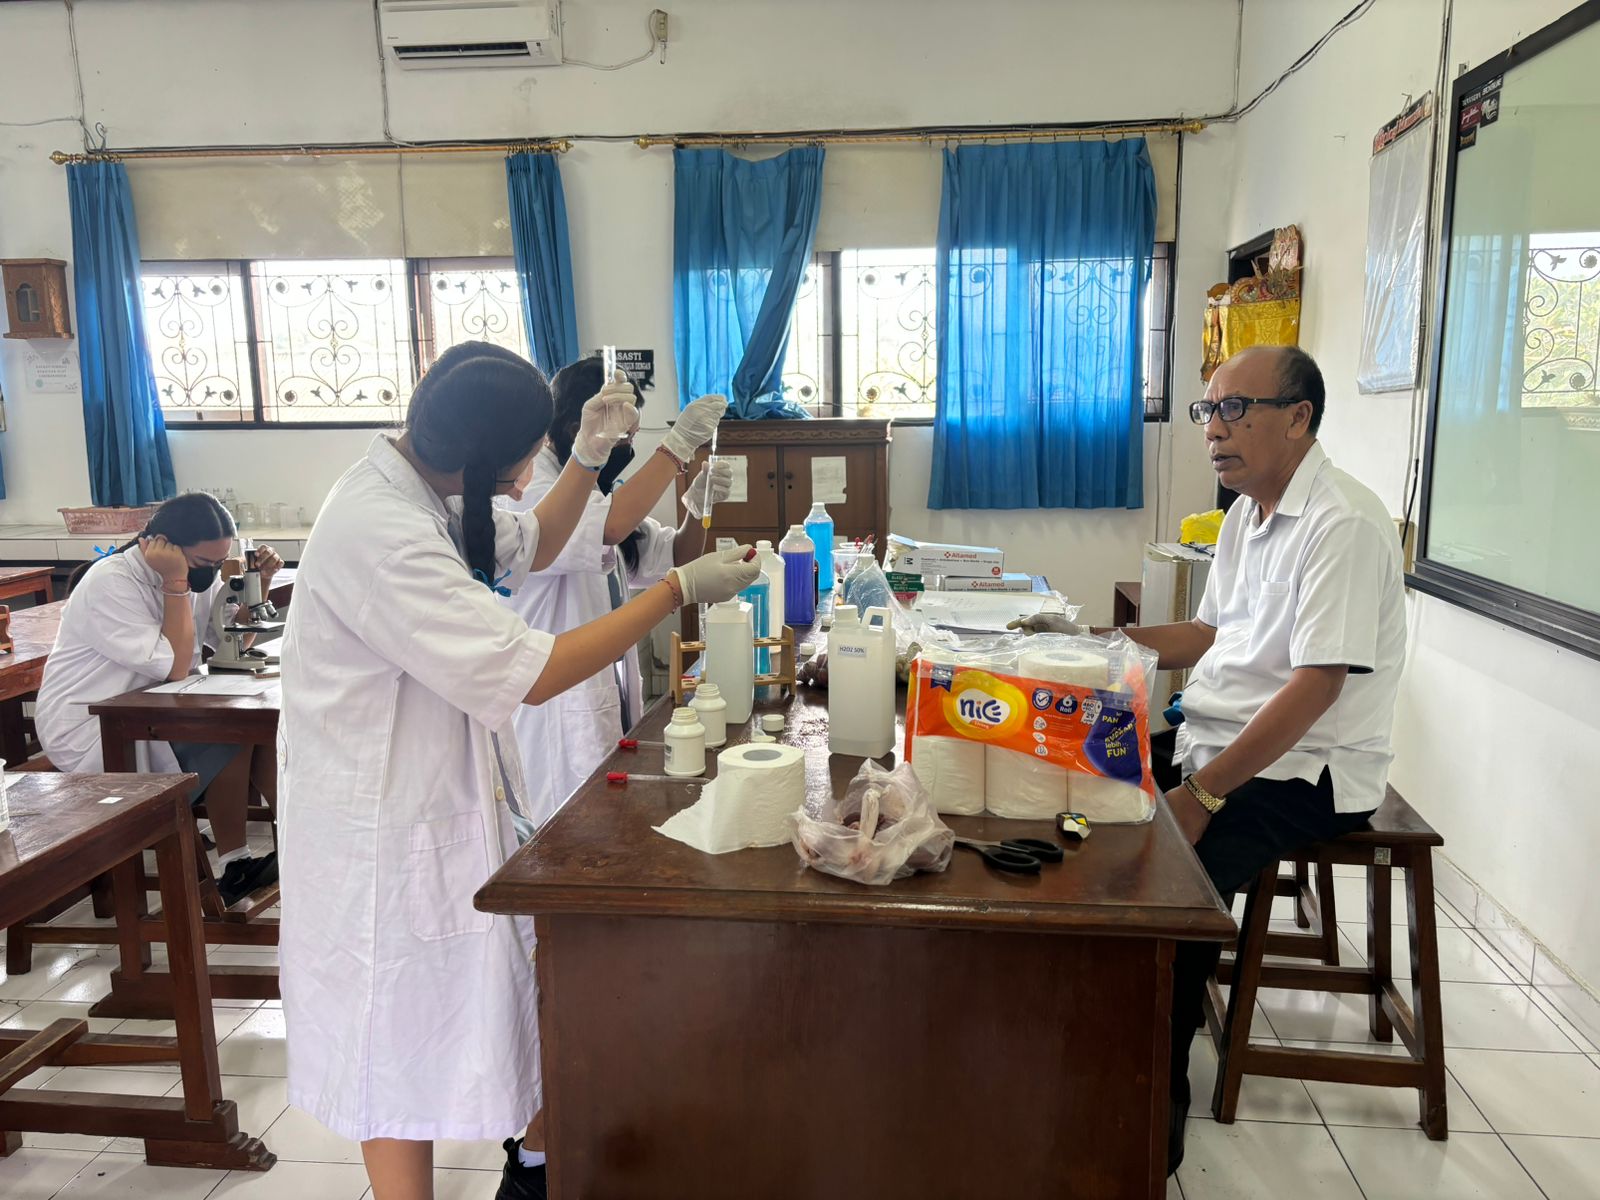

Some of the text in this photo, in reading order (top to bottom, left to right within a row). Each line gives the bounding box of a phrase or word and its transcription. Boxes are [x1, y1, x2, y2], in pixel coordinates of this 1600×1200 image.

[616, 352, 642, 361] SASTI
[1062, 695, 1072, 706] 6
[1106, 748, 1127, 758] FUN
